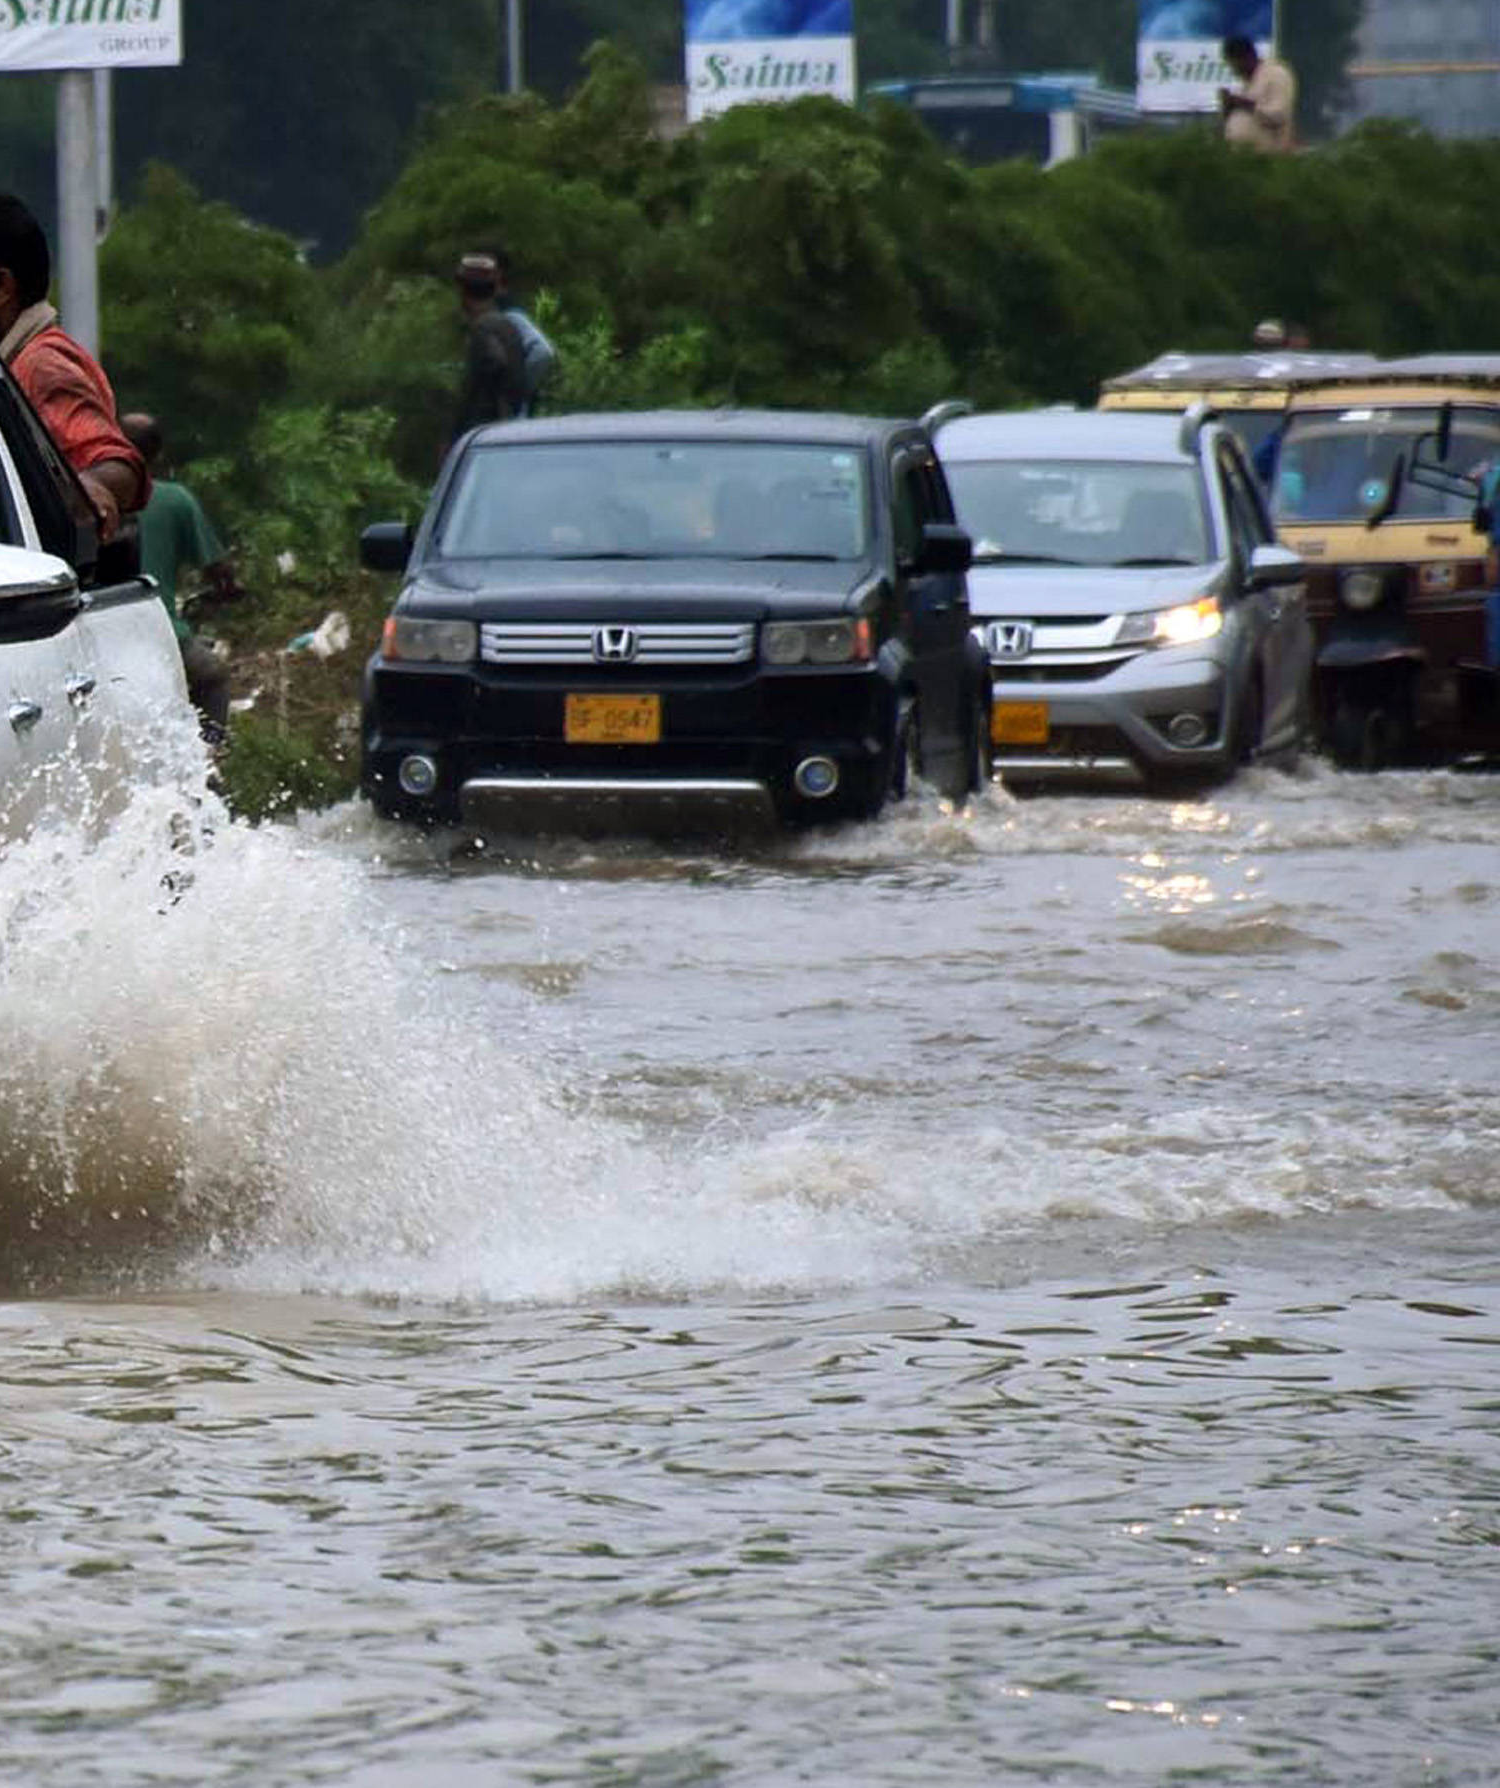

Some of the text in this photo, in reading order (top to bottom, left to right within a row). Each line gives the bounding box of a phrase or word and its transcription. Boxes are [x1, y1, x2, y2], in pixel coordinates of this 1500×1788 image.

[100, 37, 171, 52] GROUP
[698, 54, 836, 90] Saima
[1145, 51, 1235, 84] Saim
